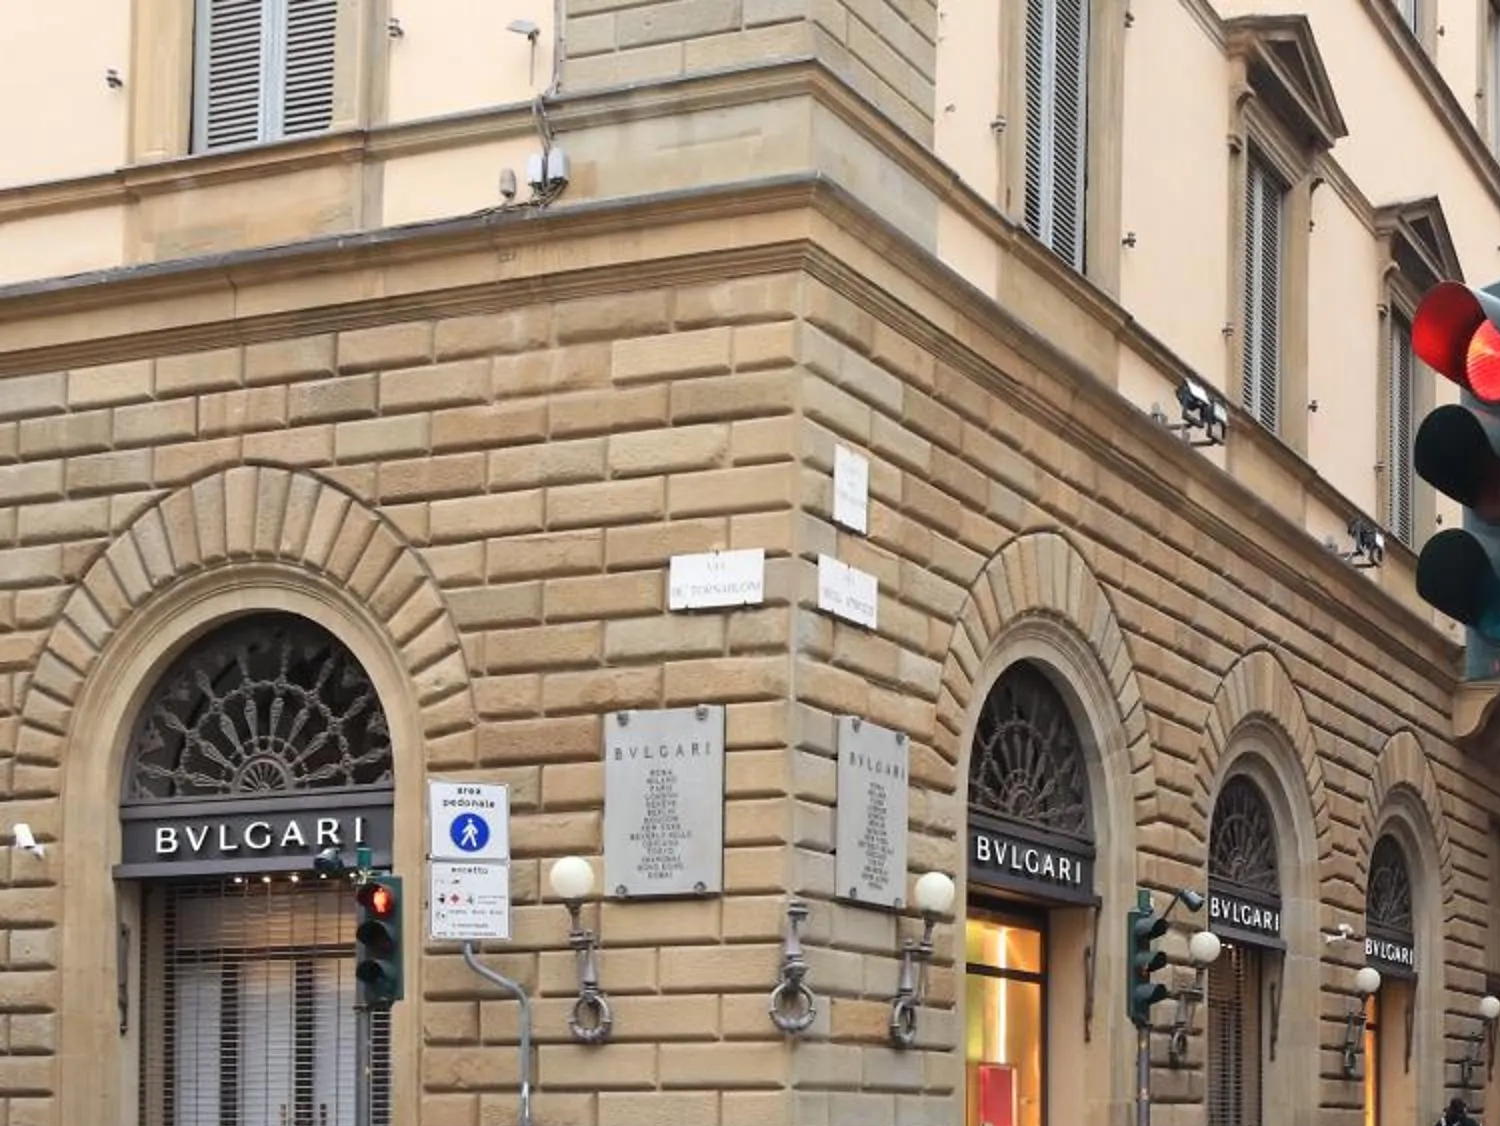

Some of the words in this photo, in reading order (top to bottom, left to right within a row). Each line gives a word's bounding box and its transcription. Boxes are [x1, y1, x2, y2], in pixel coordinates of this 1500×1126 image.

[614, 741, 711, 761] BVLGARI
[849, 751, 905, 780] BVLGARI
[442, 797, 496, 810] pedonale
[456, 786, 482, 796] area
[155, 816, 364, 855] BVLGARI
[976, 834, 1082, 885] BVLGARI
[1210, 896, 1280, 932] BVLGARI
[1364, 936, 1415, 966] BVLGARI
